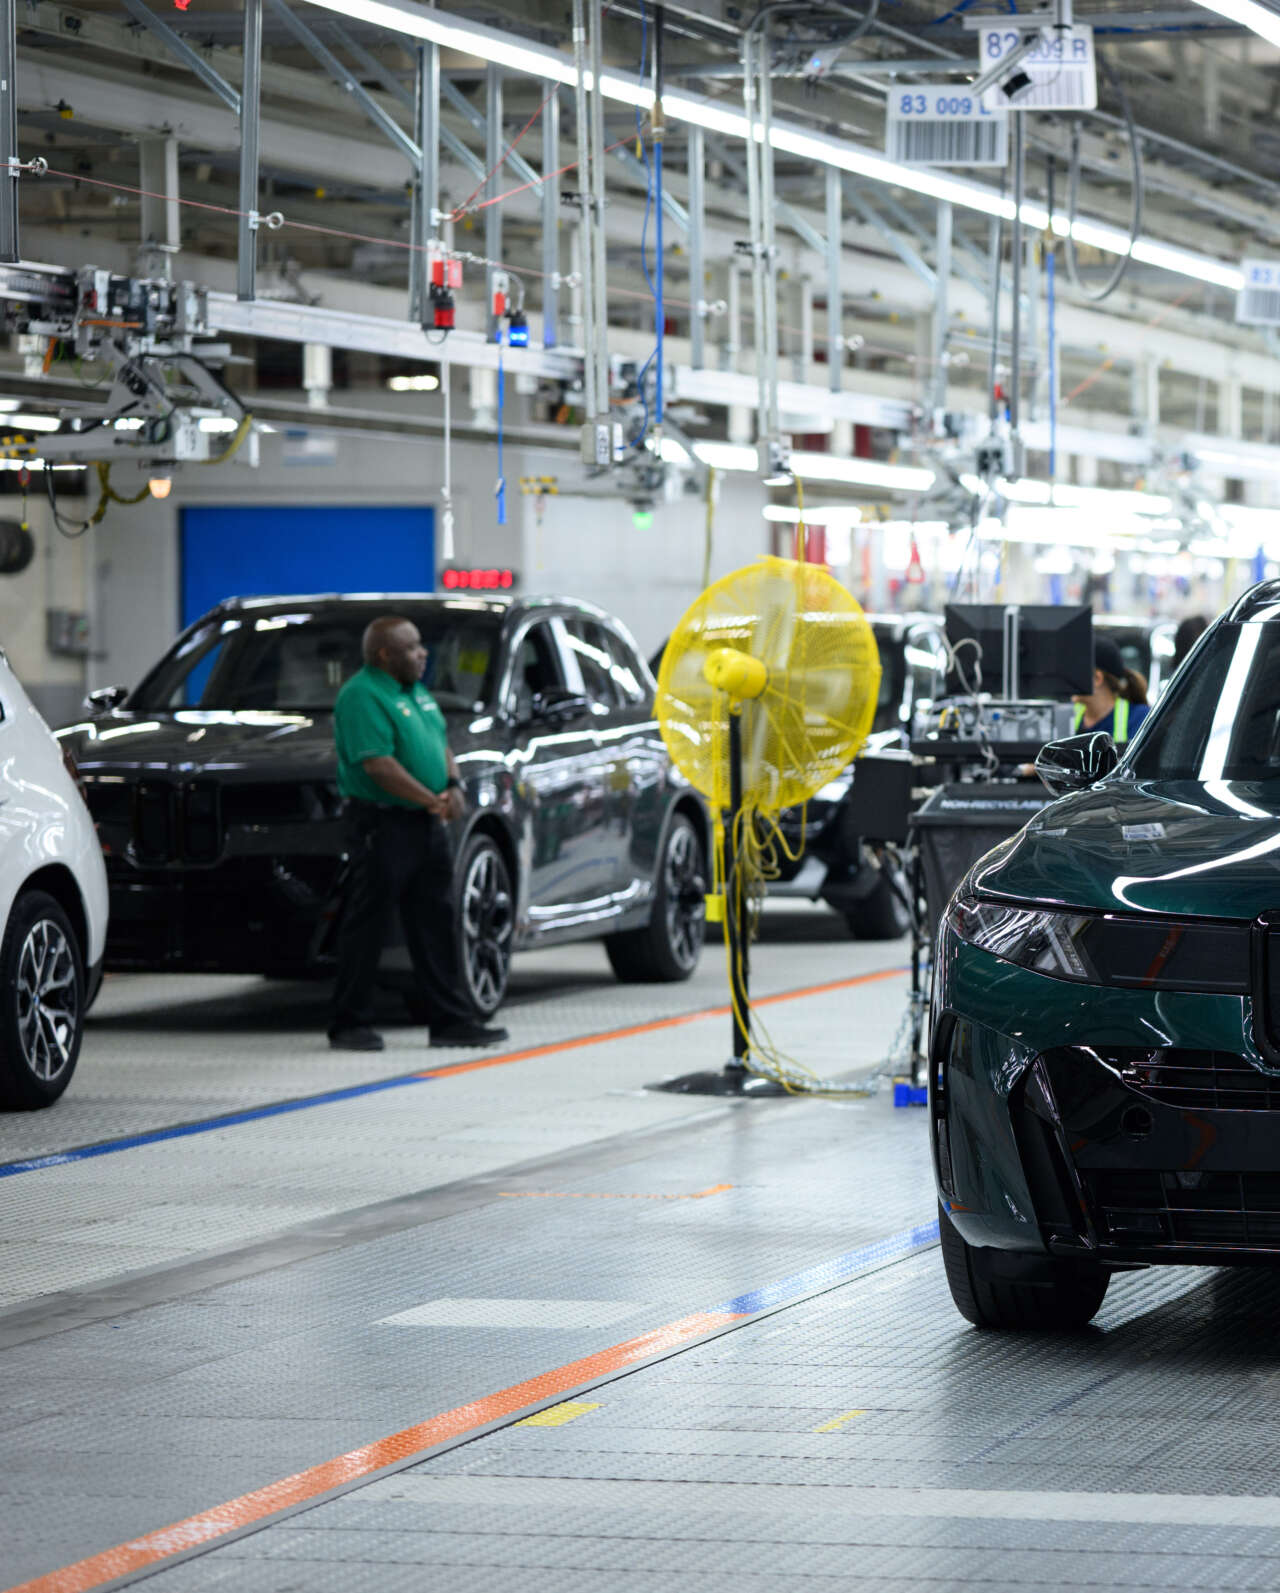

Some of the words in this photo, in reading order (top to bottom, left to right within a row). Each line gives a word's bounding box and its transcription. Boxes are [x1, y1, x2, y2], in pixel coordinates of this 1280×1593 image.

[1071, 38, 1088, 57] R
[901, 94, 928, 115] 83
[936, 97, 973, 115] 009
